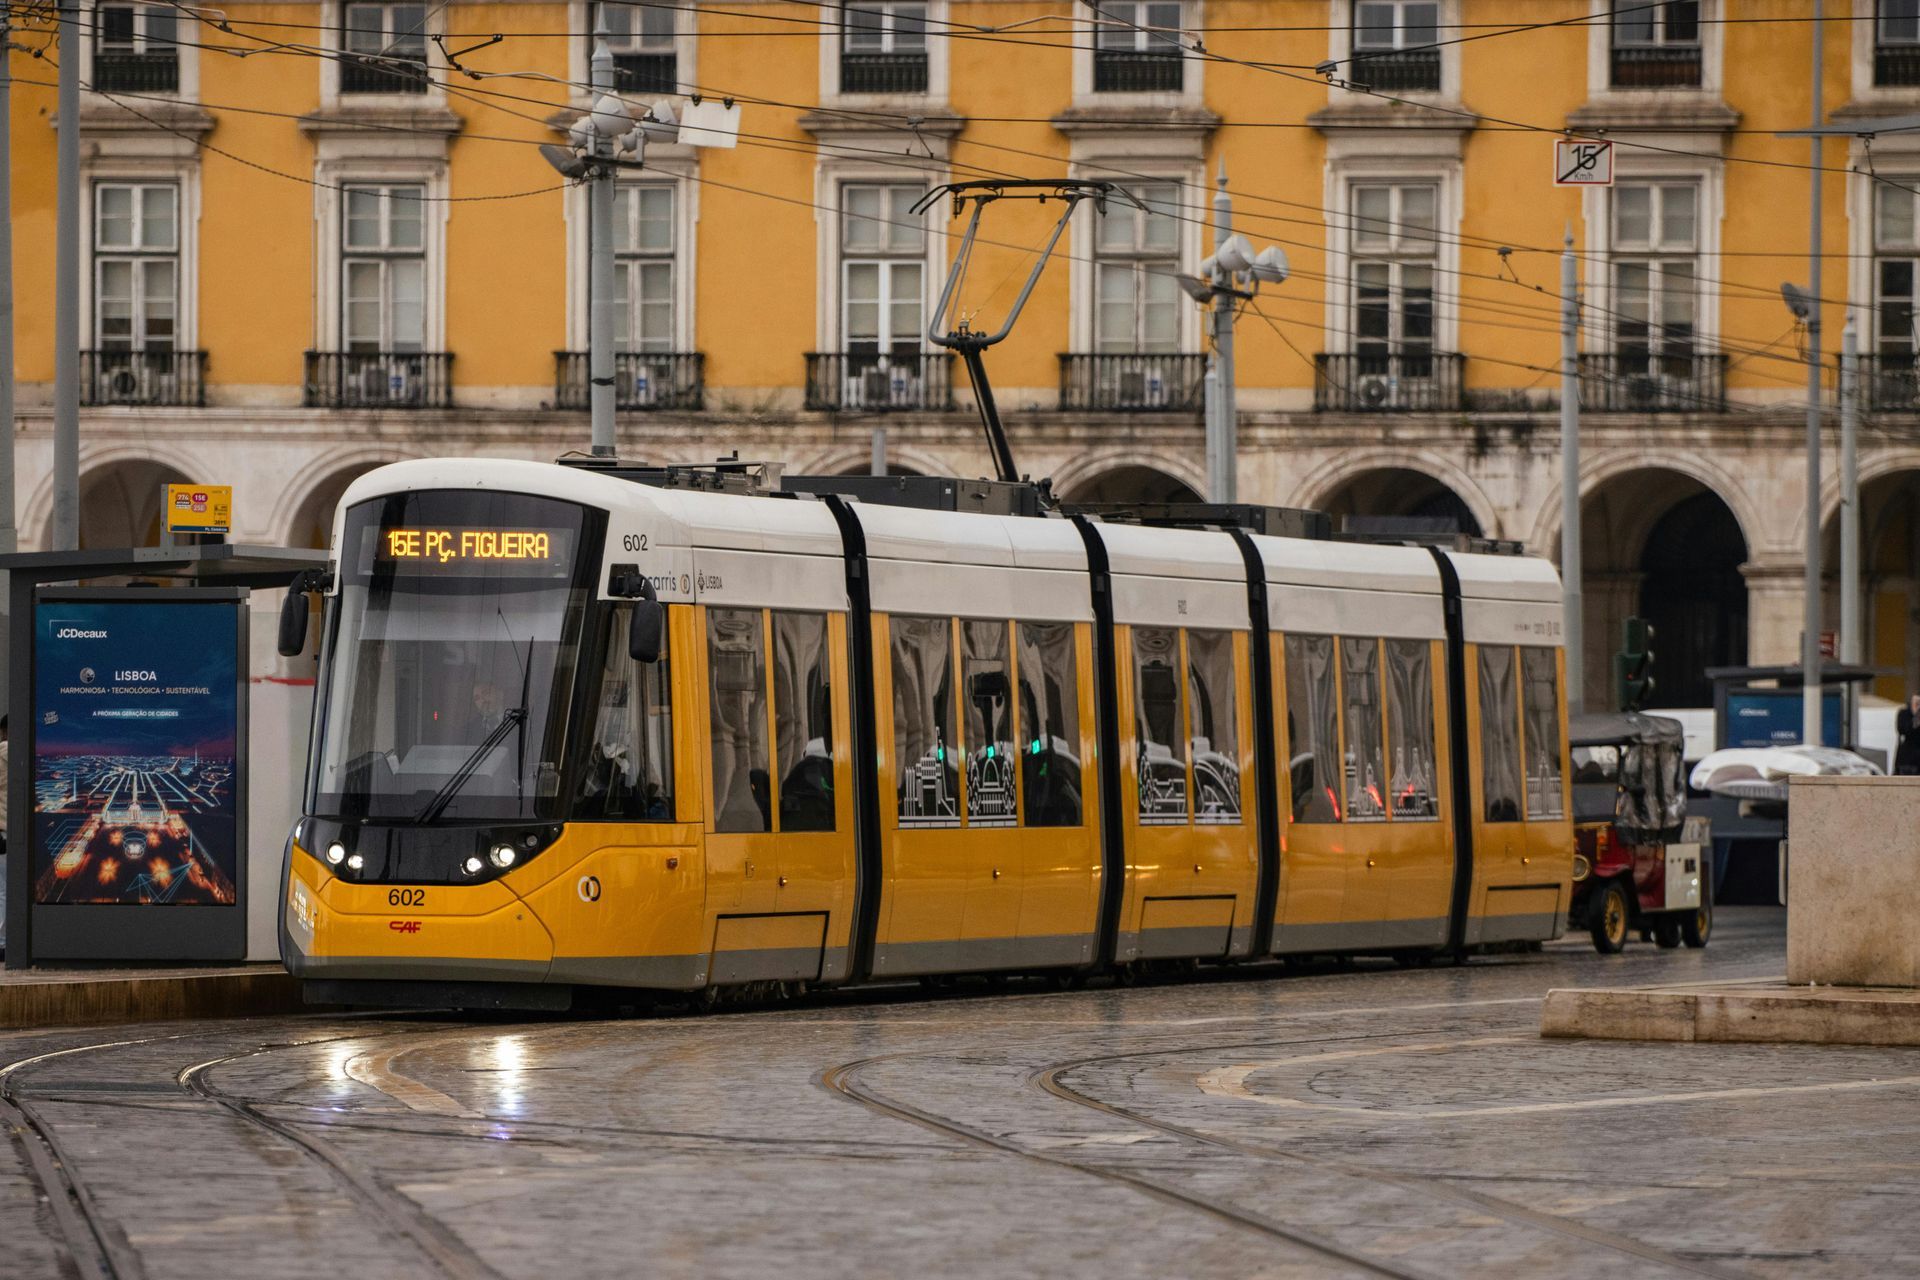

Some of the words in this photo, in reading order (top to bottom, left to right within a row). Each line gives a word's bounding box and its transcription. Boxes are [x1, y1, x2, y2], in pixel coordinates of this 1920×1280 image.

[1571, 144, 1597, 170] 15
[387, 530, 421, 556] 15E
[425, 531, 457, 563] PÇ.
[461, 532, 549, 558] FIGUEIRA
[623, 534, 648, 552] 602
[705, 575, 723, 590] LISBOA
[56, 628, 108, 639] JCDecaux
[114, 670, 157, 681] LISBOA
[111, 685, 160, 694] TECNOLÓGICA
[165, 686, 211, 695] SUSTENTÁVEL
[388, 888, 425, 906] 602
[389, 920, 422, 933] CAF
